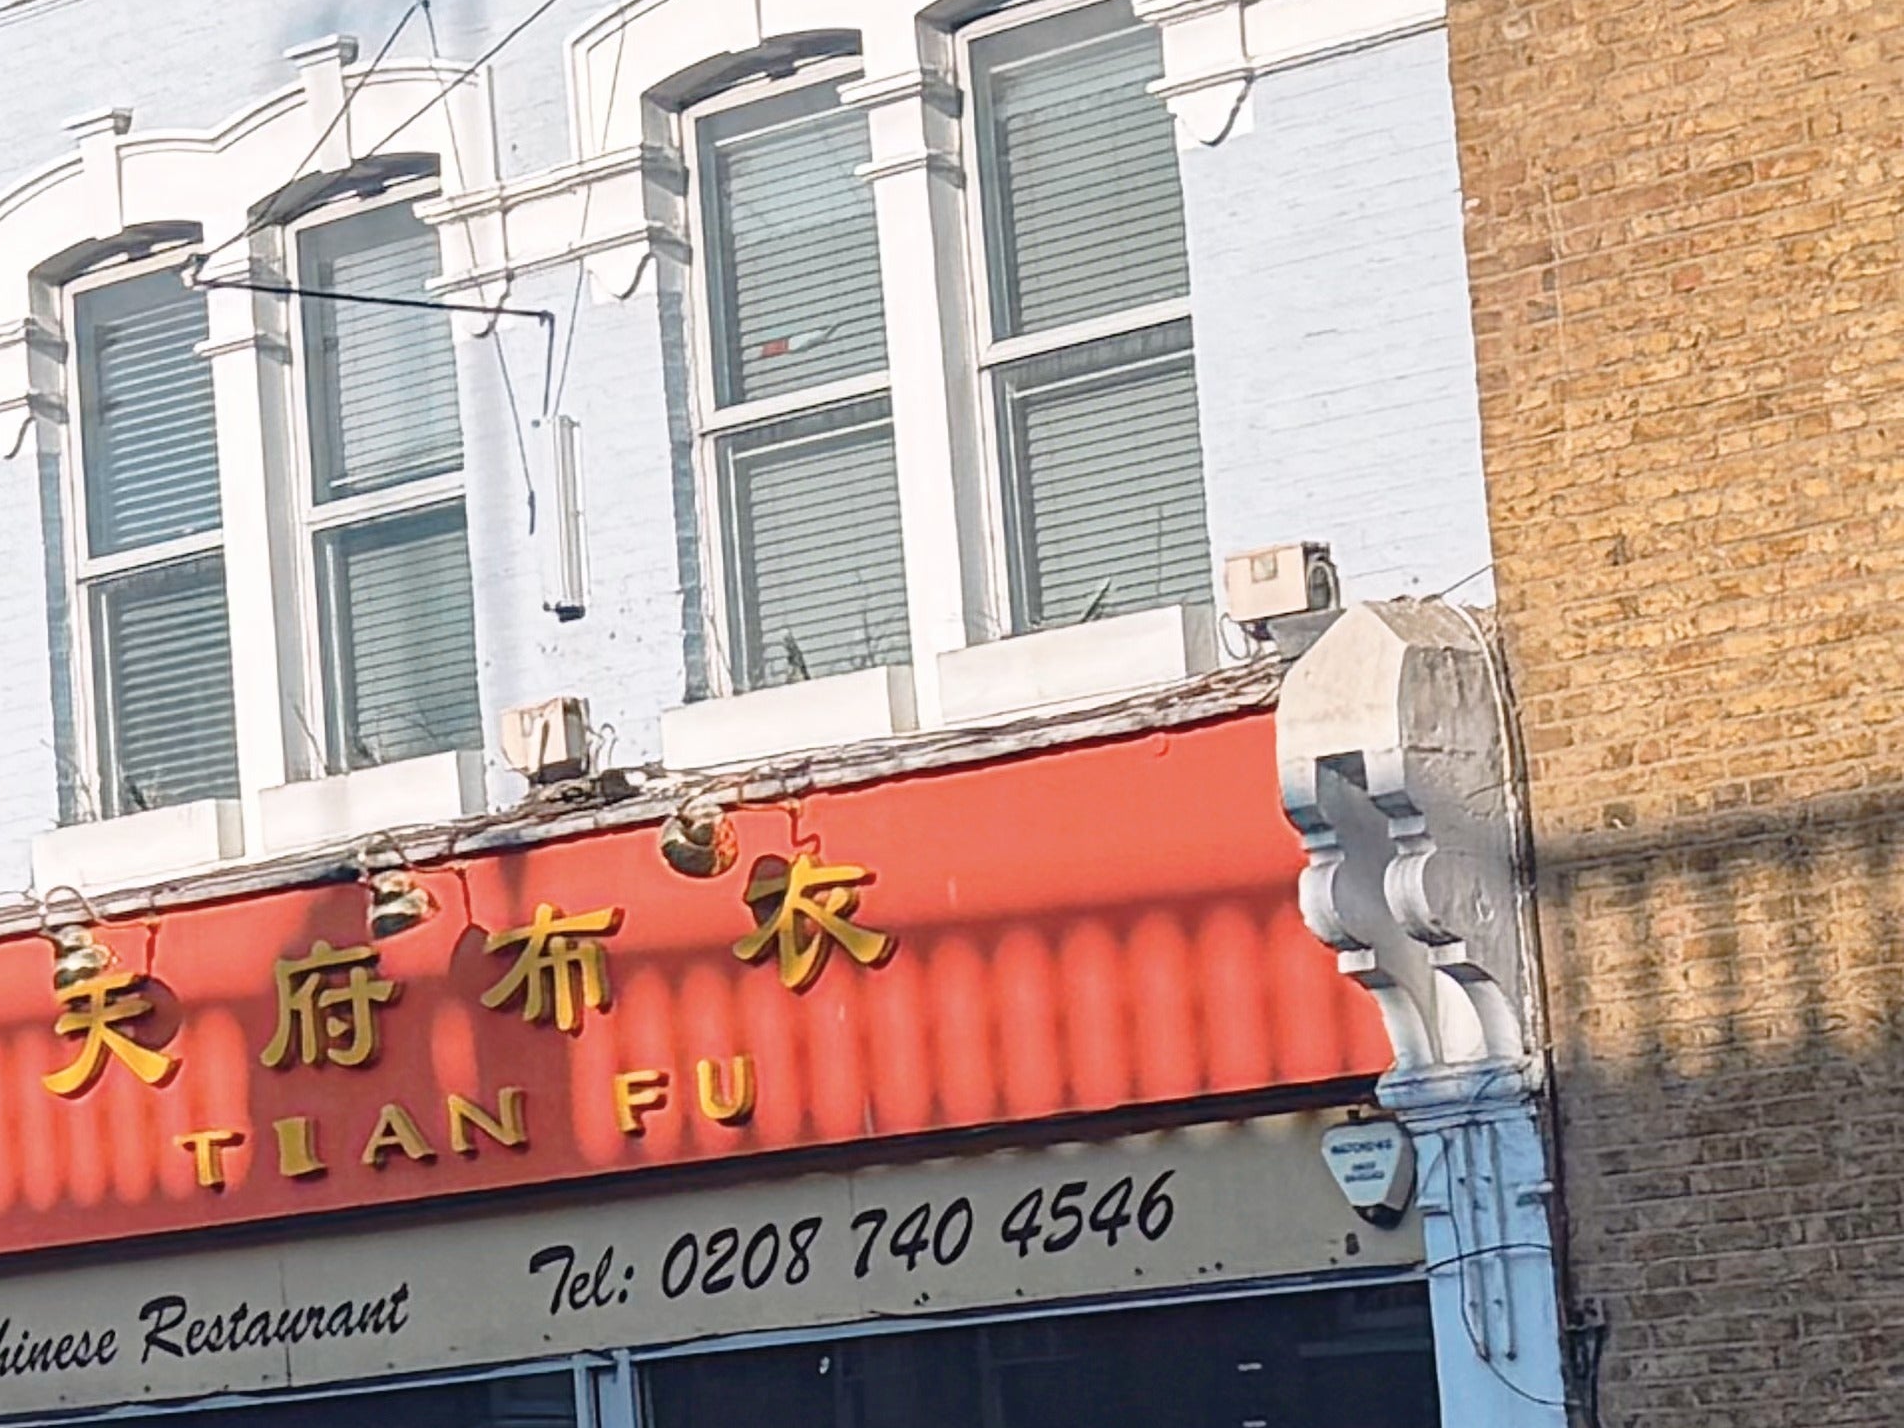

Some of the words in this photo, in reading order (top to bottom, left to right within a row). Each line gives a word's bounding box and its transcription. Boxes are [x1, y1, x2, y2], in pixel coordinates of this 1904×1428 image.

[174, 1086, 527, 1189] TIAN
[613, 1054, 754, 1135] FU
[138, 1282, 409, 1363] Restaurant
[529, 1244, 634, 1315] Tel:
[661, 1217, 823, 1297] 0208
[850, 1196, 974, 1278] 740
[1000, 1170, 1176, 1258] 4546
